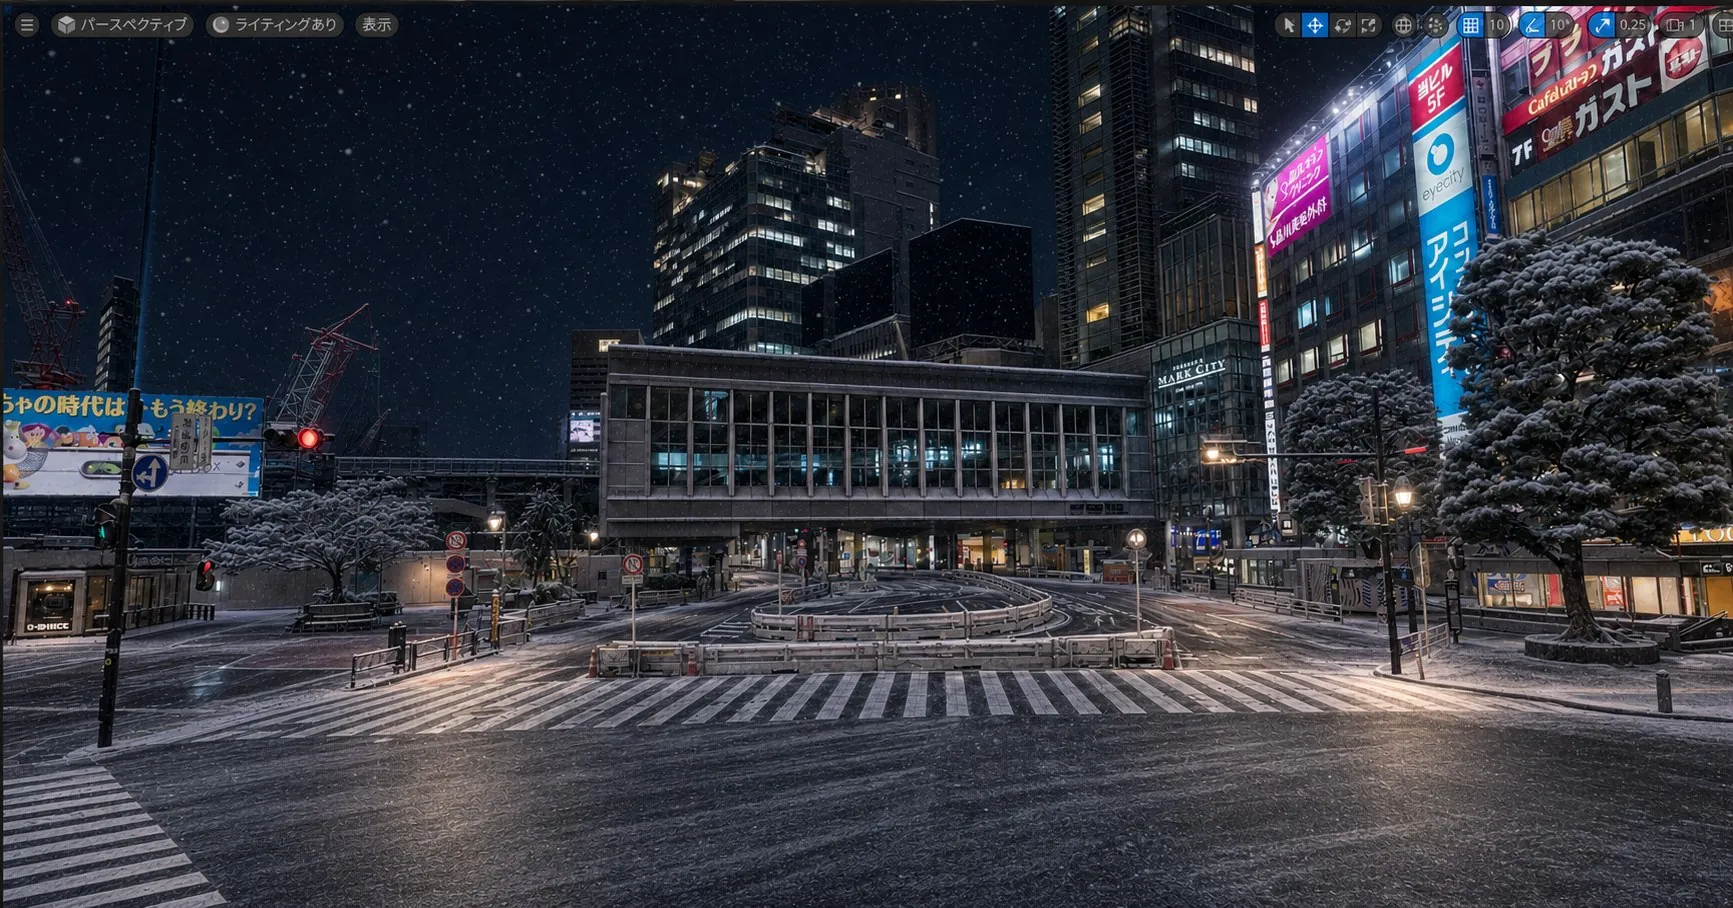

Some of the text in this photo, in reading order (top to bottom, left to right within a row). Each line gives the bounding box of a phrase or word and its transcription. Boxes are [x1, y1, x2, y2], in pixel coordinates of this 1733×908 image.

[1418, 62, 1453, 100] 当ビル
[1427, 86, 1446, 114] 5F
[1575, 72, 1653, 138] ガスト
[1511, 138, 1533, 166] 7F
[1422, 166, 1465, 202] eyecity
[1158, 368, 1192, 386] MARK
[1195, 359, 1226, 375] CITY
